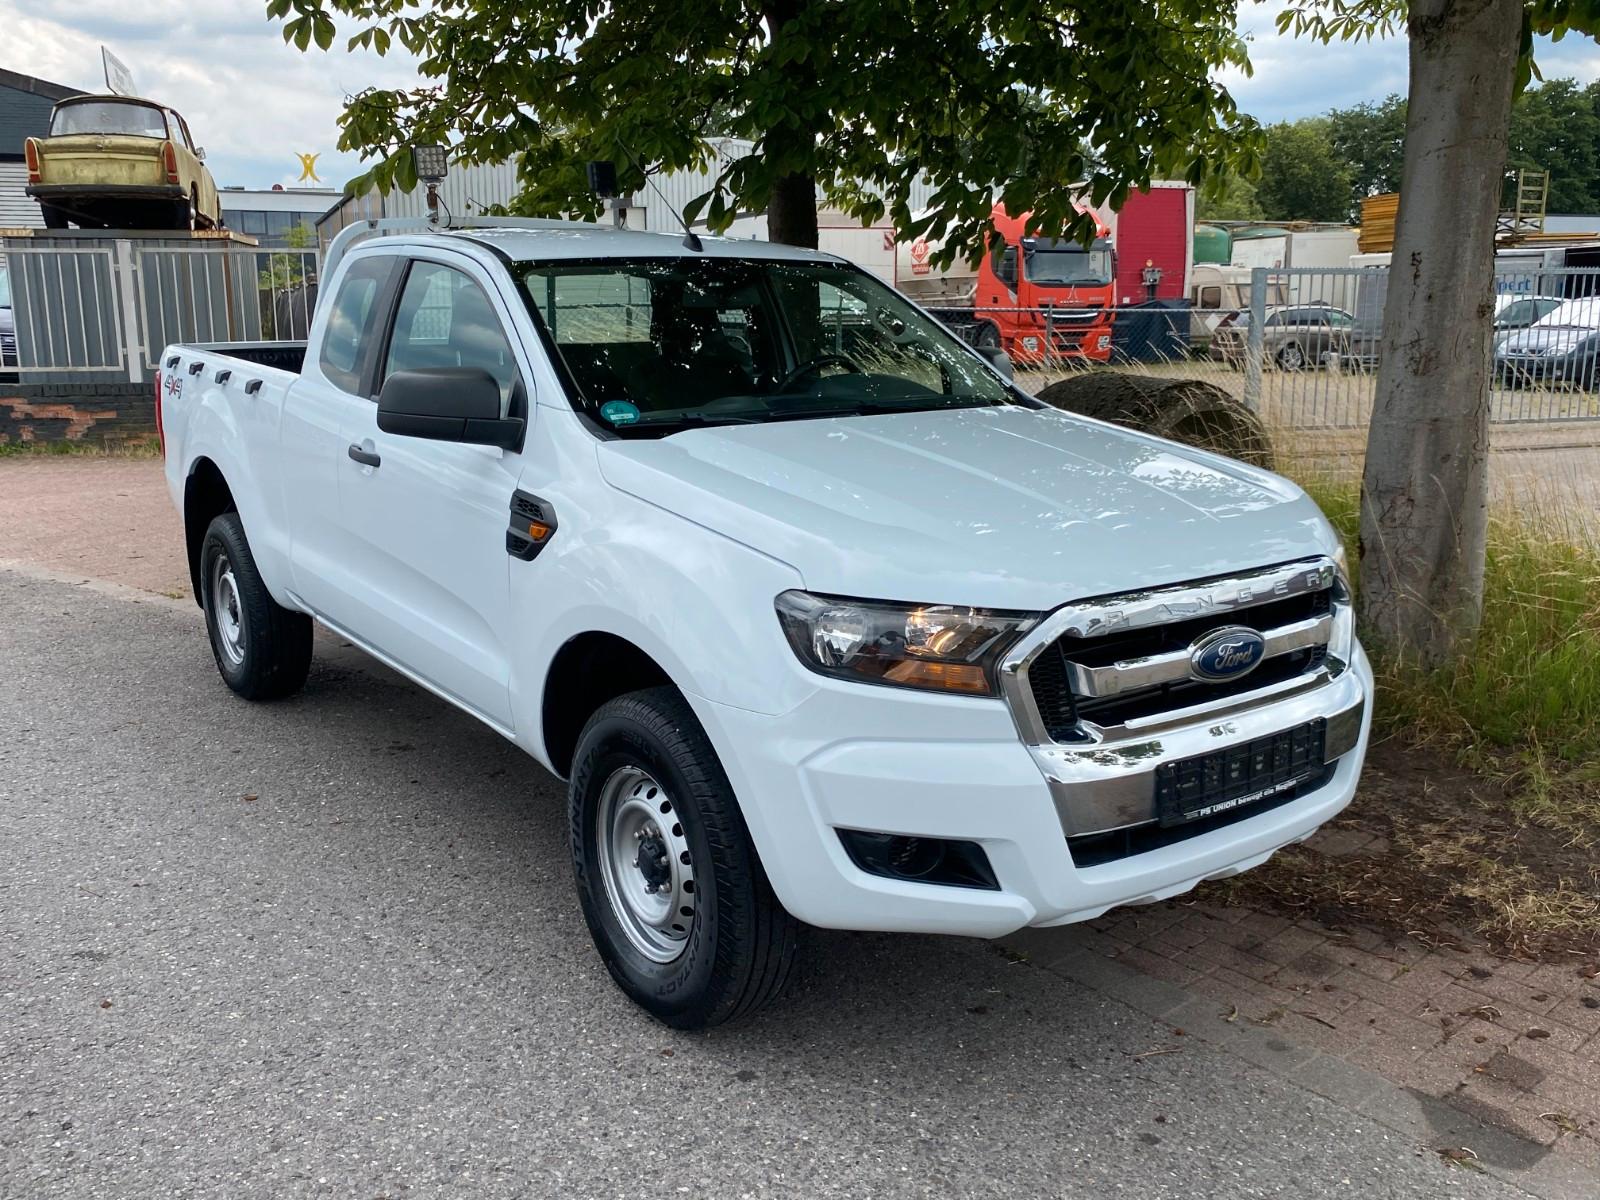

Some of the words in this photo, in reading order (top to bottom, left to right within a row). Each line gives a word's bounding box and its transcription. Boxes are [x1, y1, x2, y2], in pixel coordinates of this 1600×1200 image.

[1104, 572, 1321, 627] RANGER
[1214, 640, 1254, 671] Ford
[1200, 806, 1211, 816] PS
[1213, 799, 1237, 811] UNION
